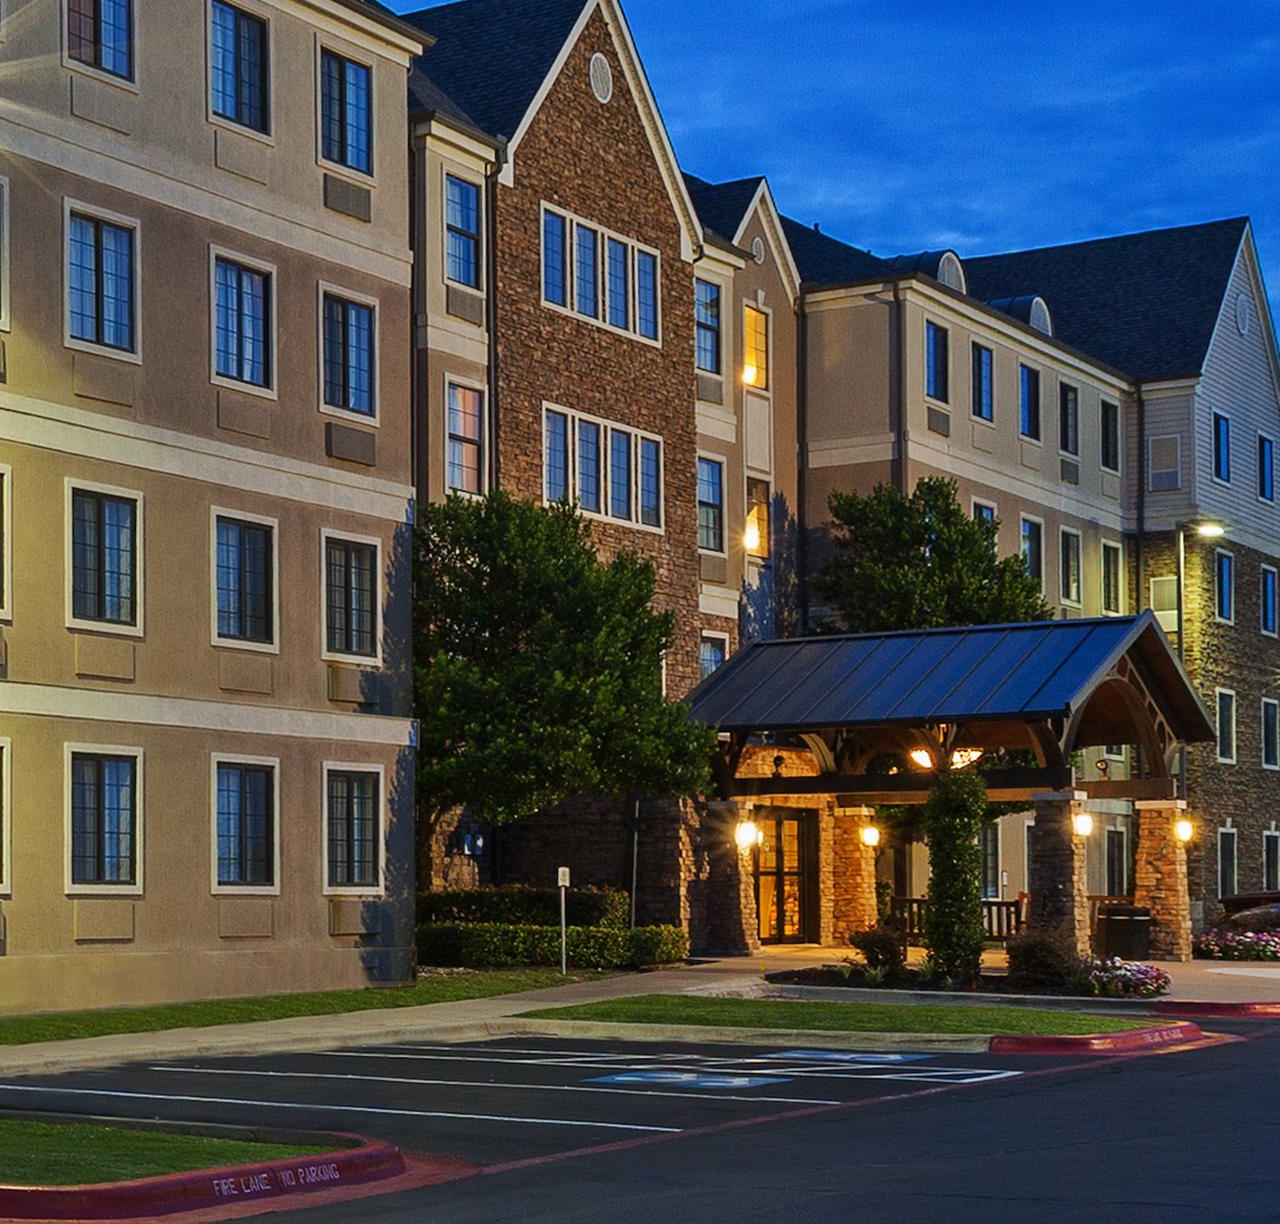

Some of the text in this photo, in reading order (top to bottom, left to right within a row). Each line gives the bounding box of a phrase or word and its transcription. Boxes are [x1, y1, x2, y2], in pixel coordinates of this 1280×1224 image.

[213, 1163, 339, 1195] FIRE LANE NO PARKING
